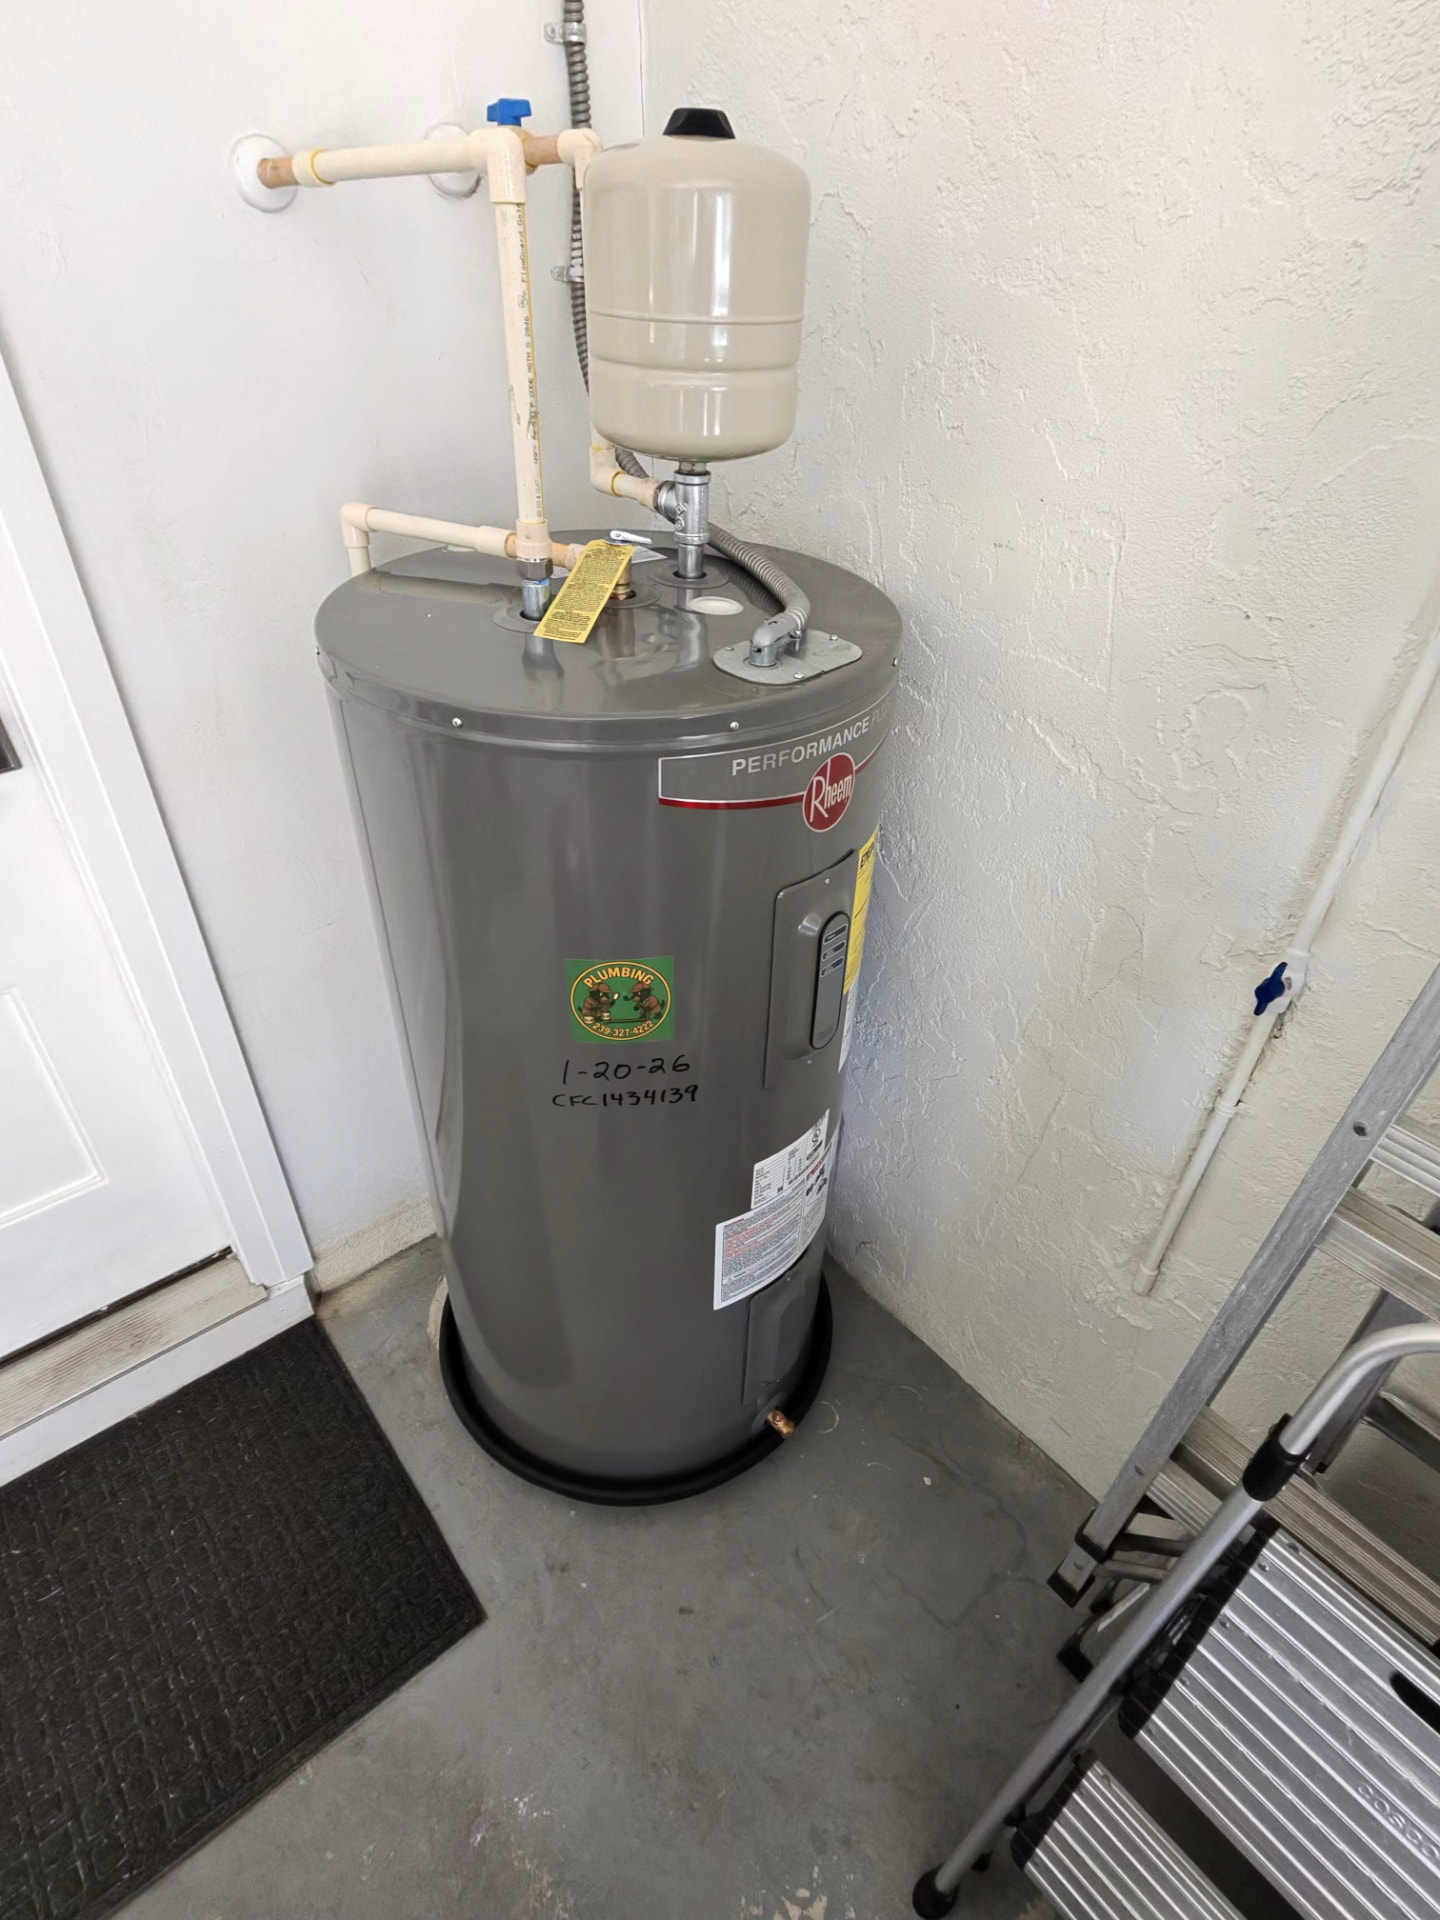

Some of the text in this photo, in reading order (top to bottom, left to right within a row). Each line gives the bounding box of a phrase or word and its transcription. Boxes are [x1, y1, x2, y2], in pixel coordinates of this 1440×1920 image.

[732, 716, 870, 776] PERFORMANCE
[809, 759, 853, 823] Rheem
[583, 966, 655, 988] PLUMBING
[592, 1020, 655, 1037] 239-327-4222
[562, 1054, 690, 1085] 1-20-26
